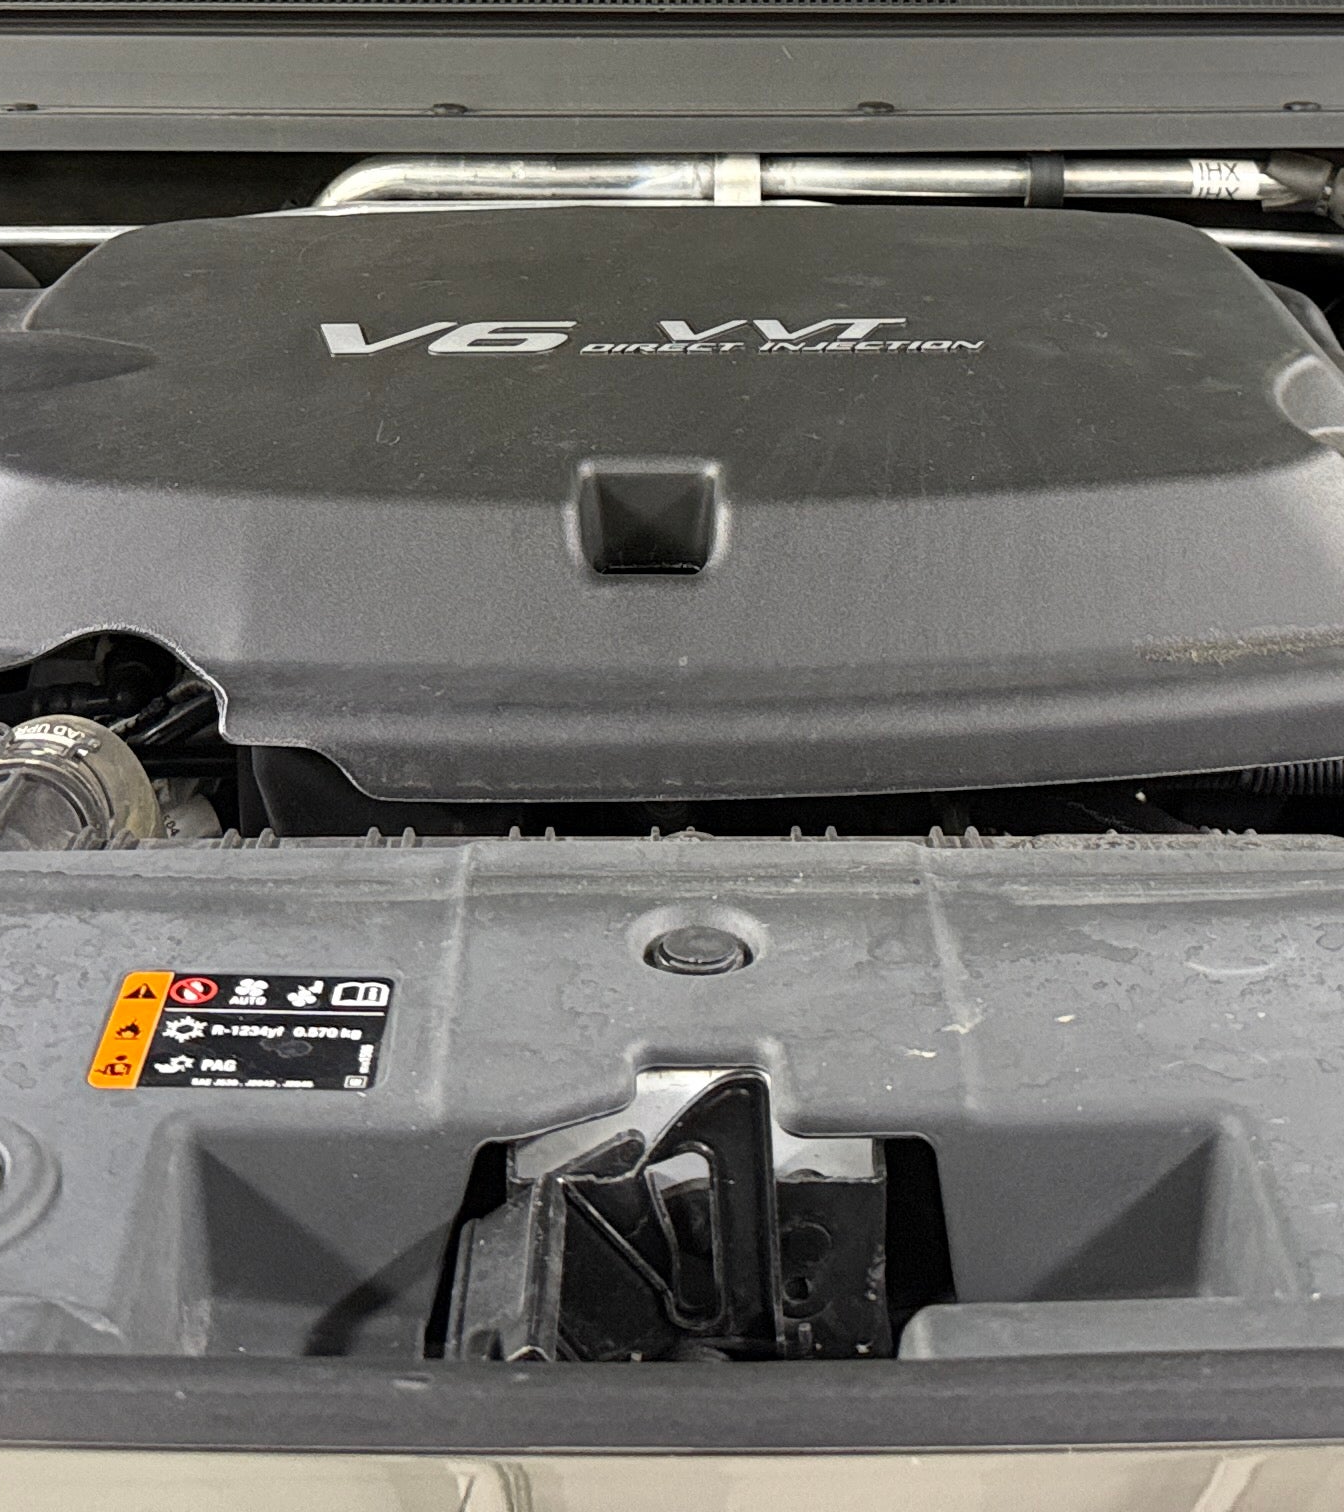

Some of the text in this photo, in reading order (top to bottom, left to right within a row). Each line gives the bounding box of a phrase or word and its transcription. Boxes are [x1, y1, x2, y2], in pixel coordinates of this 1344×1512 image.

[1198, 161, 1241, 181] IHX
[319, 317, 907, 357] V6 VVT
[579, 340, 985, 355] DIRECT INJECTION
[229, 995, 267, 1006] AUTO
[211, 1024, 285, 1039] R-1234yf
[340, 1028, 362, 1040] kg
[200, 1059, 237, 1072] PAG
